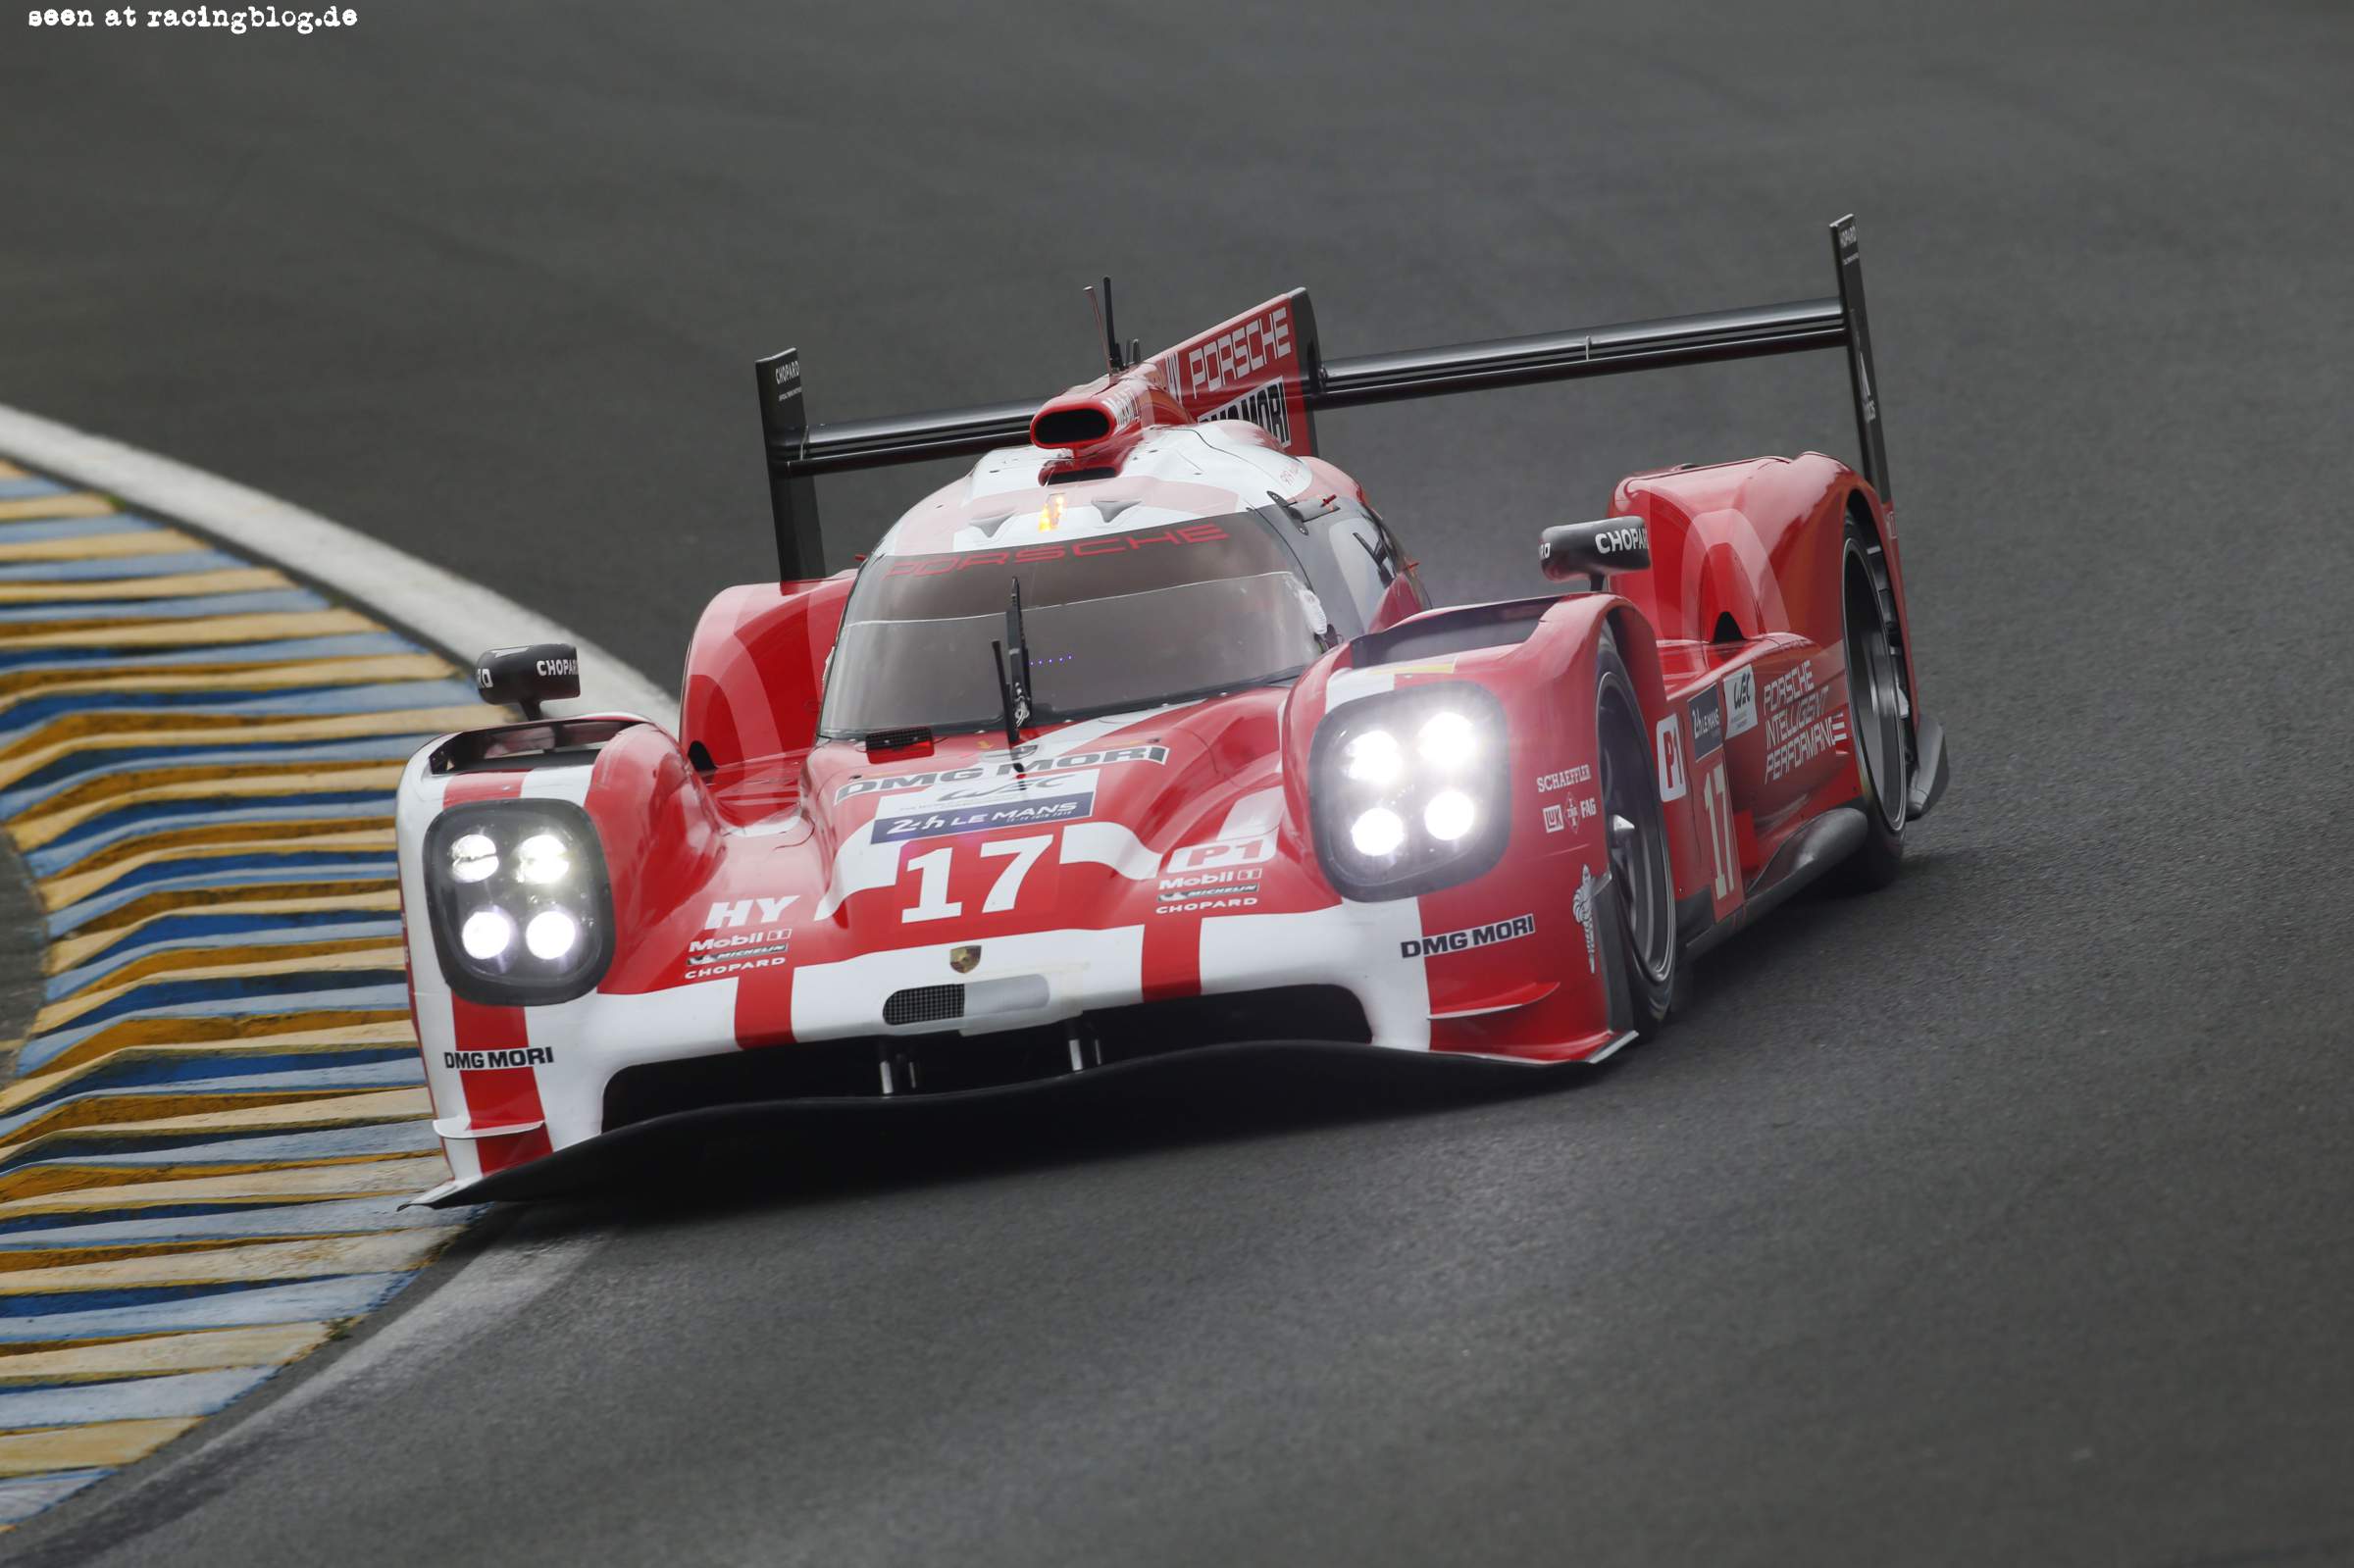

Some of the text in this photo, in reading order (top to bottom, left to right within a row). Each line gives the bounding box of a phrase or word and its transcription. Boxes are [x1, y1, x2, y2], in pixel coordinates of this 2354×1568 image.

[1188, 307, 1292, 400] PORSCHE
[882, 524, 1230, 580] PORSCHE
[1764, 660, 1815, 716] PORSCHE
[1663, 727, 1683, 789] P1
[836, 746, 1167, 799] DMG MORI
[1537, 764, 1592, 792] SCHAEFFLER
[950, 813, 987, 826] LE
[992, 802, 1078, 821] MANS
[1580, 797, 1597, 818] FAG
[1704, 761, 1735, 900] 17
[1187, 839, 1263, 867] P1
[901, 835, 1053, 923] 17
[1158, 871, 1234, 890] Mobil
[1188, 885, 1257, 896] MICHELIN
[704, 895, 801, 930] HY
[1155, 897, 1258, 914] CHOPARD
[689, 932, 763, 953] Mobil
[1401, 915, 1535, 959] DMG MORI
[716, 944, 786, 959] MICHELIN
[685, 957, 787, 980] CHOPARD
[443, 1046, 555, 1069] DMG MORI
